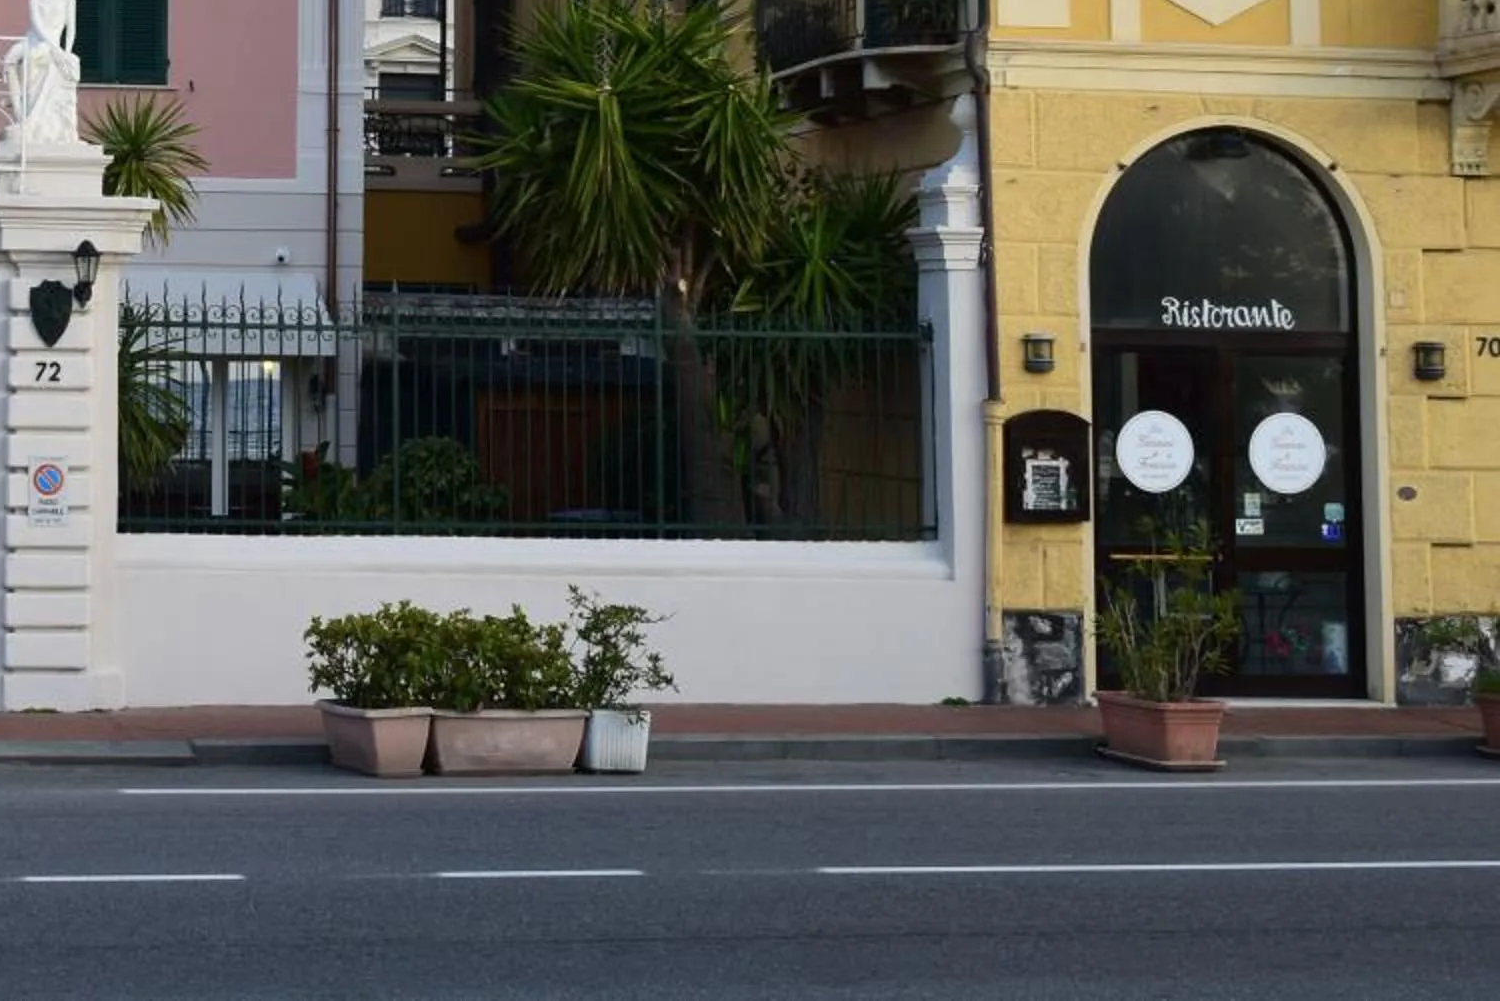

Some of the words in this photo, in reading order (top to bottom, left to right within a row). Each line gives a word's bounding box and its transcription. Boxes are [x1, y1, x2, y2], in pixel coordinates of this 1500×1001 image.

[1160, 296, 1296, 330] Ristorante
[1475, 336, 1500, 358] 70
[34, 361, 62, 382] 72
